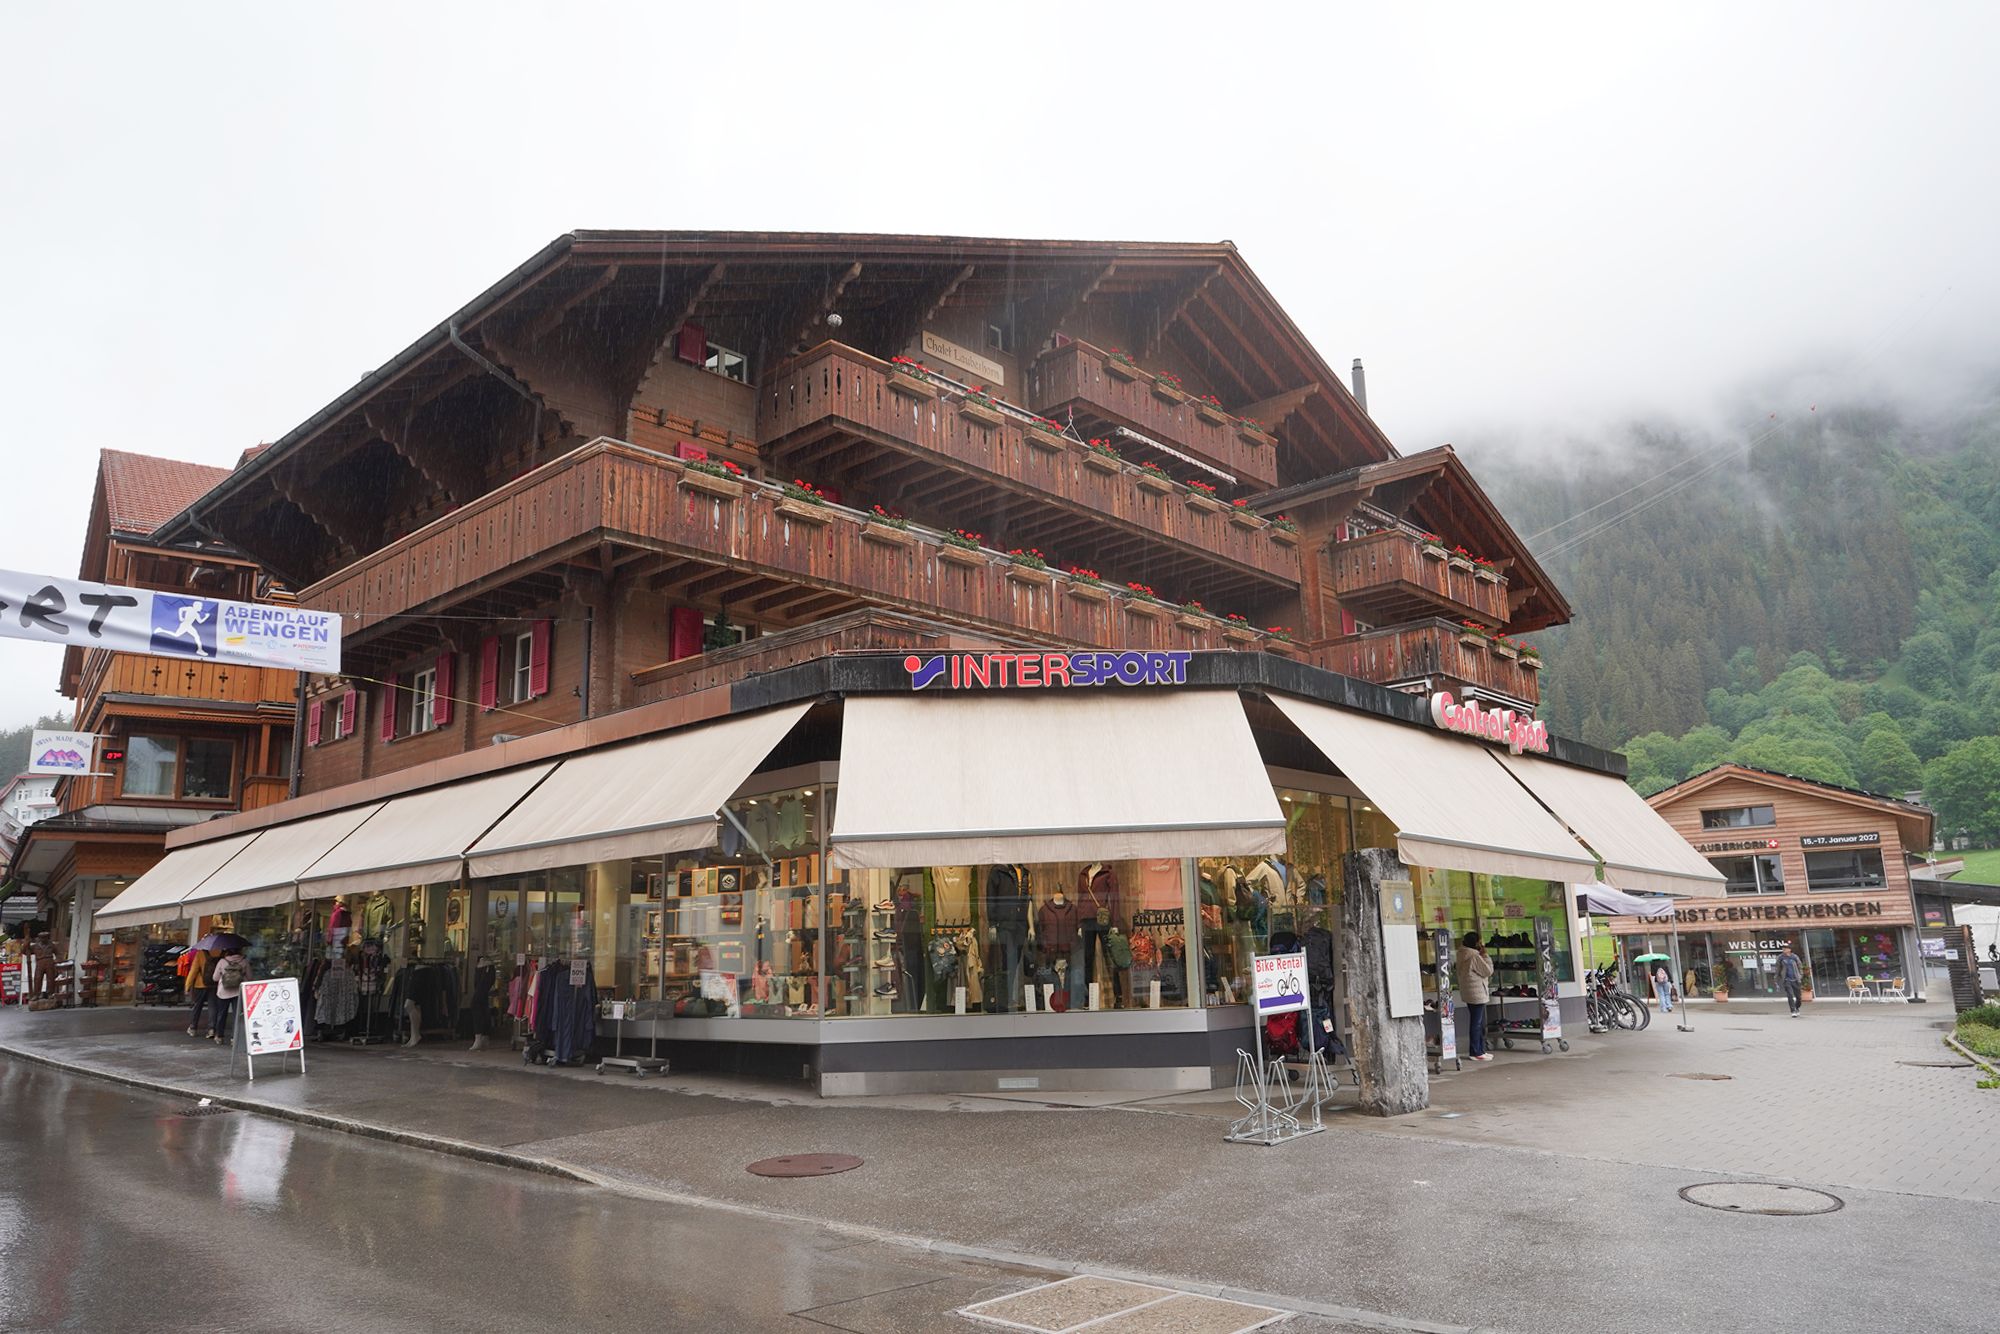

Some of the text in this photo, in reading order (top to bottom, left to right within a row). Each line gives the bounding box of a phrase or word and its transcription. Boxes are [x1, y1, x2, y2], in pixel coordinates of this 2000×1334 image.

[926, 337, 952, 357] Chalet
[0, 585, 138, 638] RT
[225, 606, 328, 627] ABENDLAUF
[224, 618, 328, 642] WENGEN
[951, 651, 1192, 689] INTERSPORT
[1434, 691, 1550, 755] Central Sport
[1803, 834, 1878, 845] 15.-17. Januar 2027
[1714, 905, 1790, 921] CENTER
[1794, 902, 1882, 919] WENGEN
[1541, 921, 1552, 973] SALE
[1255, 956, 1303, 973] Bike Rental
[1440, 934, 1451, 989] SALE
